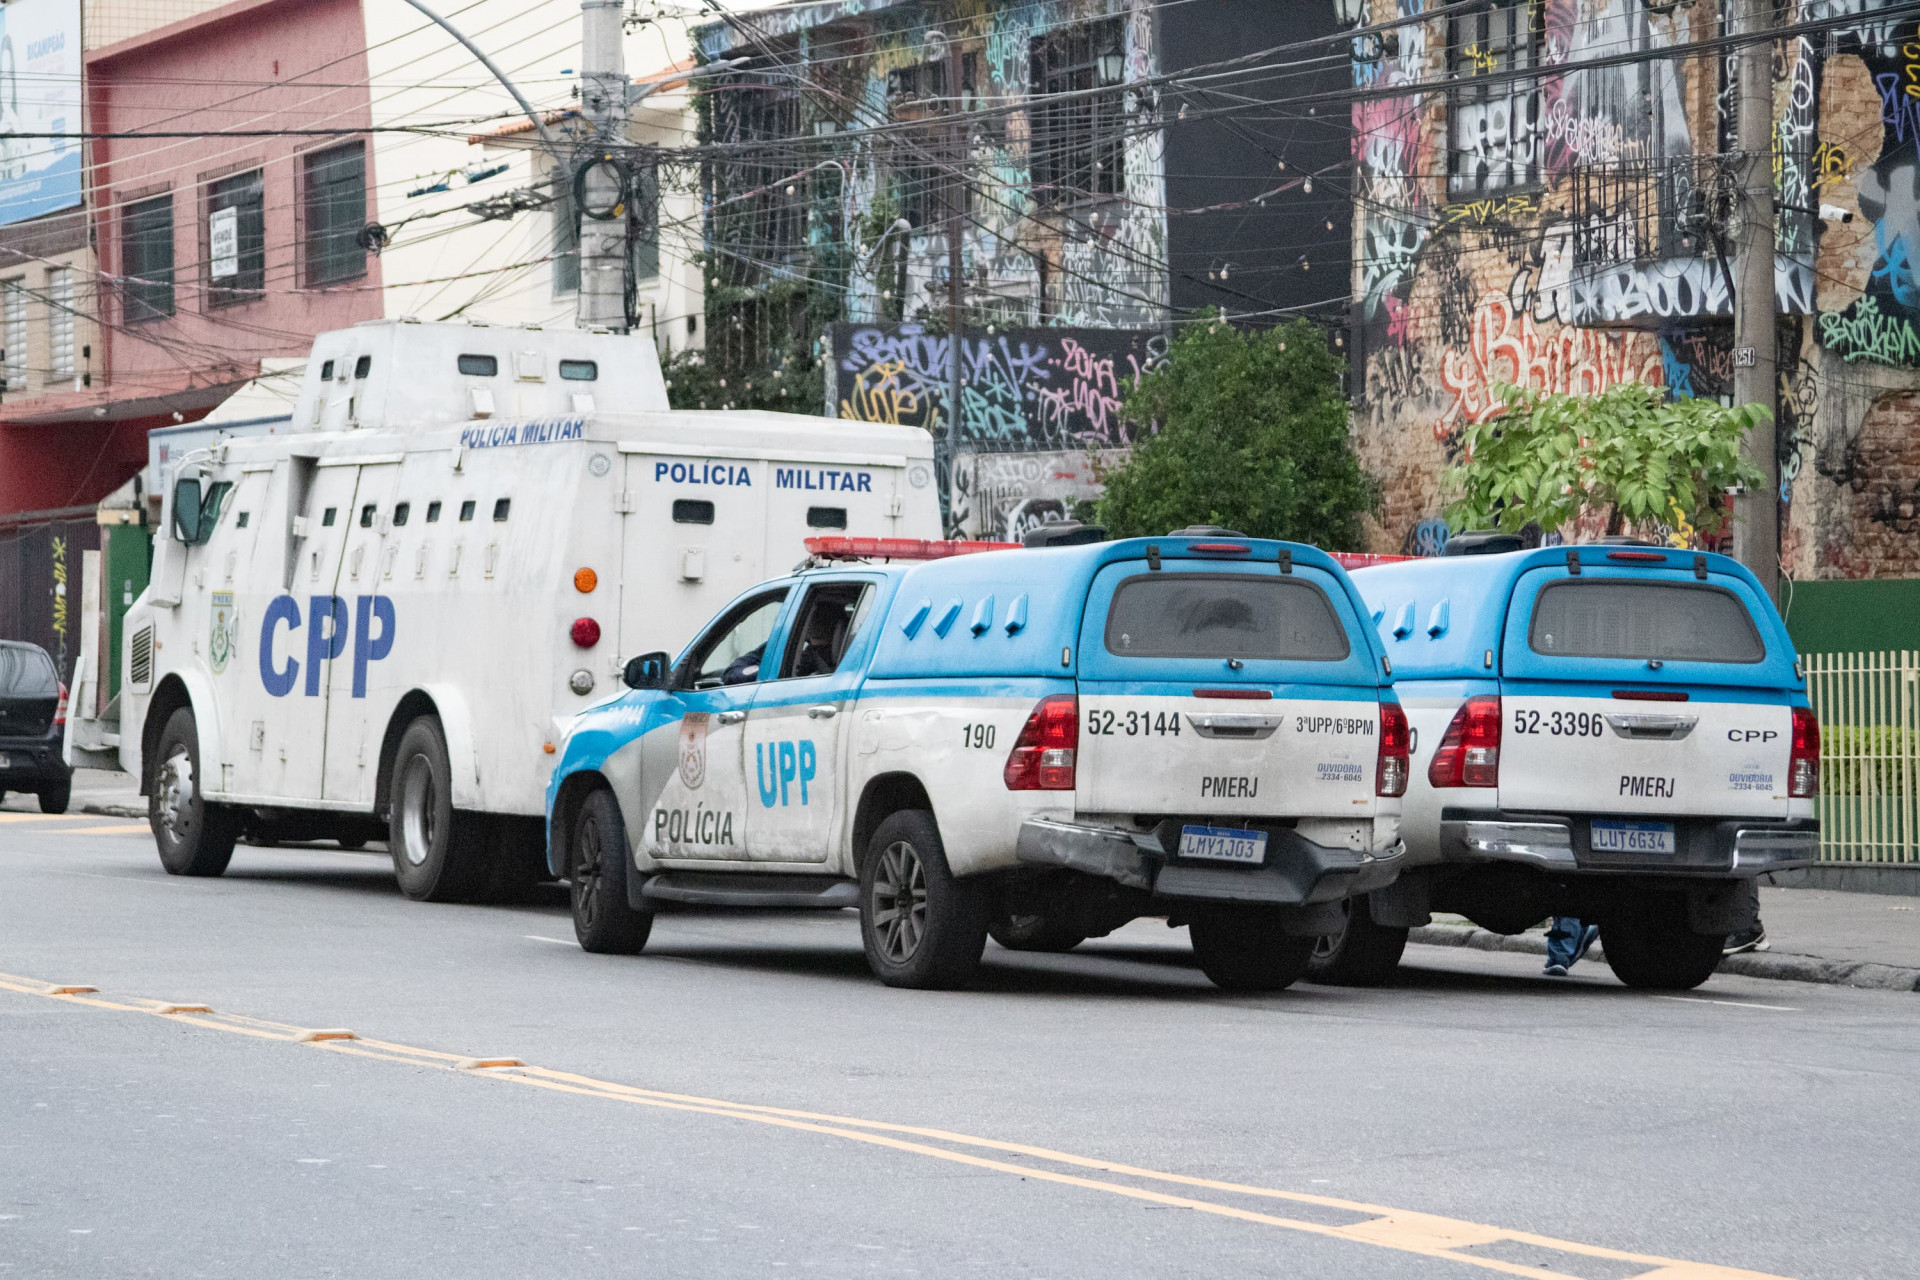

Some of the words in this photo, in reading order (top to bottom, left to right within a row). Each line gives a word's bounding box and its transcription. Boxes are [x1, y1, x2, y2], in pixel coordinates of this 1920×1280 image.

[1734, 347, 1752, 366] 1251
[655, 458, 752, 487] POLÍCIA
[776, 468, 872, 493] MILITAR
[259, 594, 396, 699] CPP
[1088, 709, 1181, 737] 52-3144
[1514, 709, 1603, 738] 52-3396
[963, 723, 996, 749] 190
[1727, 729, 1778, 743] CPP
[756, 739, 817, 809] UPP
[1317, 763, 1362, 774] OUVIDORIA
[1729, 773, 1773, 783] OUVIDORIA
[1201, 776, 1259, 799] PMERJ
[1619, 775, 1676, 798] PMERJ
[655, 801, 734, 846] POLÍCIA
[1186, 836, 1256, 859] LMY1J03
[1599, 830, 1665, 850] LUT6G34
